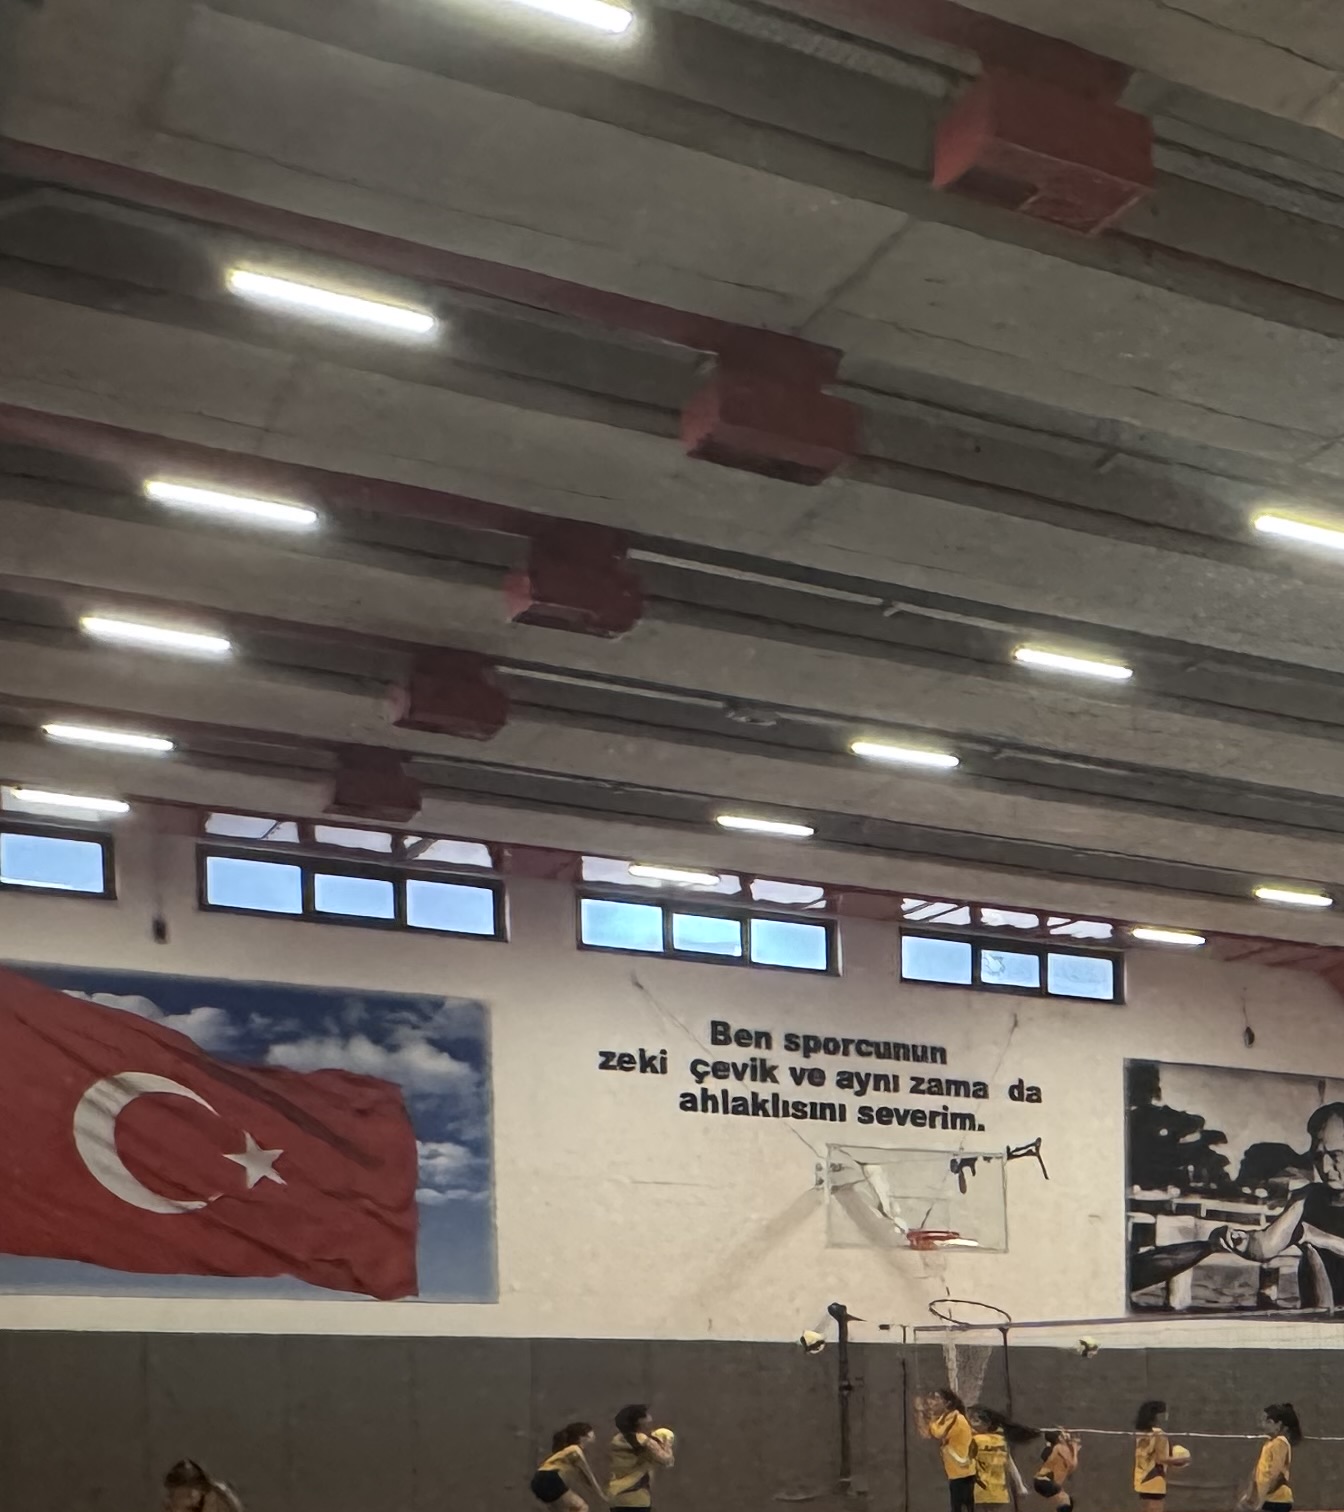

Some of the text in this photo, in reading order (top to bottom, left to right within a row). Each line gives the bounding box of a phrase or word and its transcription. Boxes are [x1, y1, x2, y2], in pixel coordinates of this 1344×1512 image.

[710, 1020, 947, 1065] Ben sporcunun
[598, 1048, 1042, 1104] zeki çevik ve aynı zama da
[679, 1087, 985, 1132] ahlaklısını severim.
